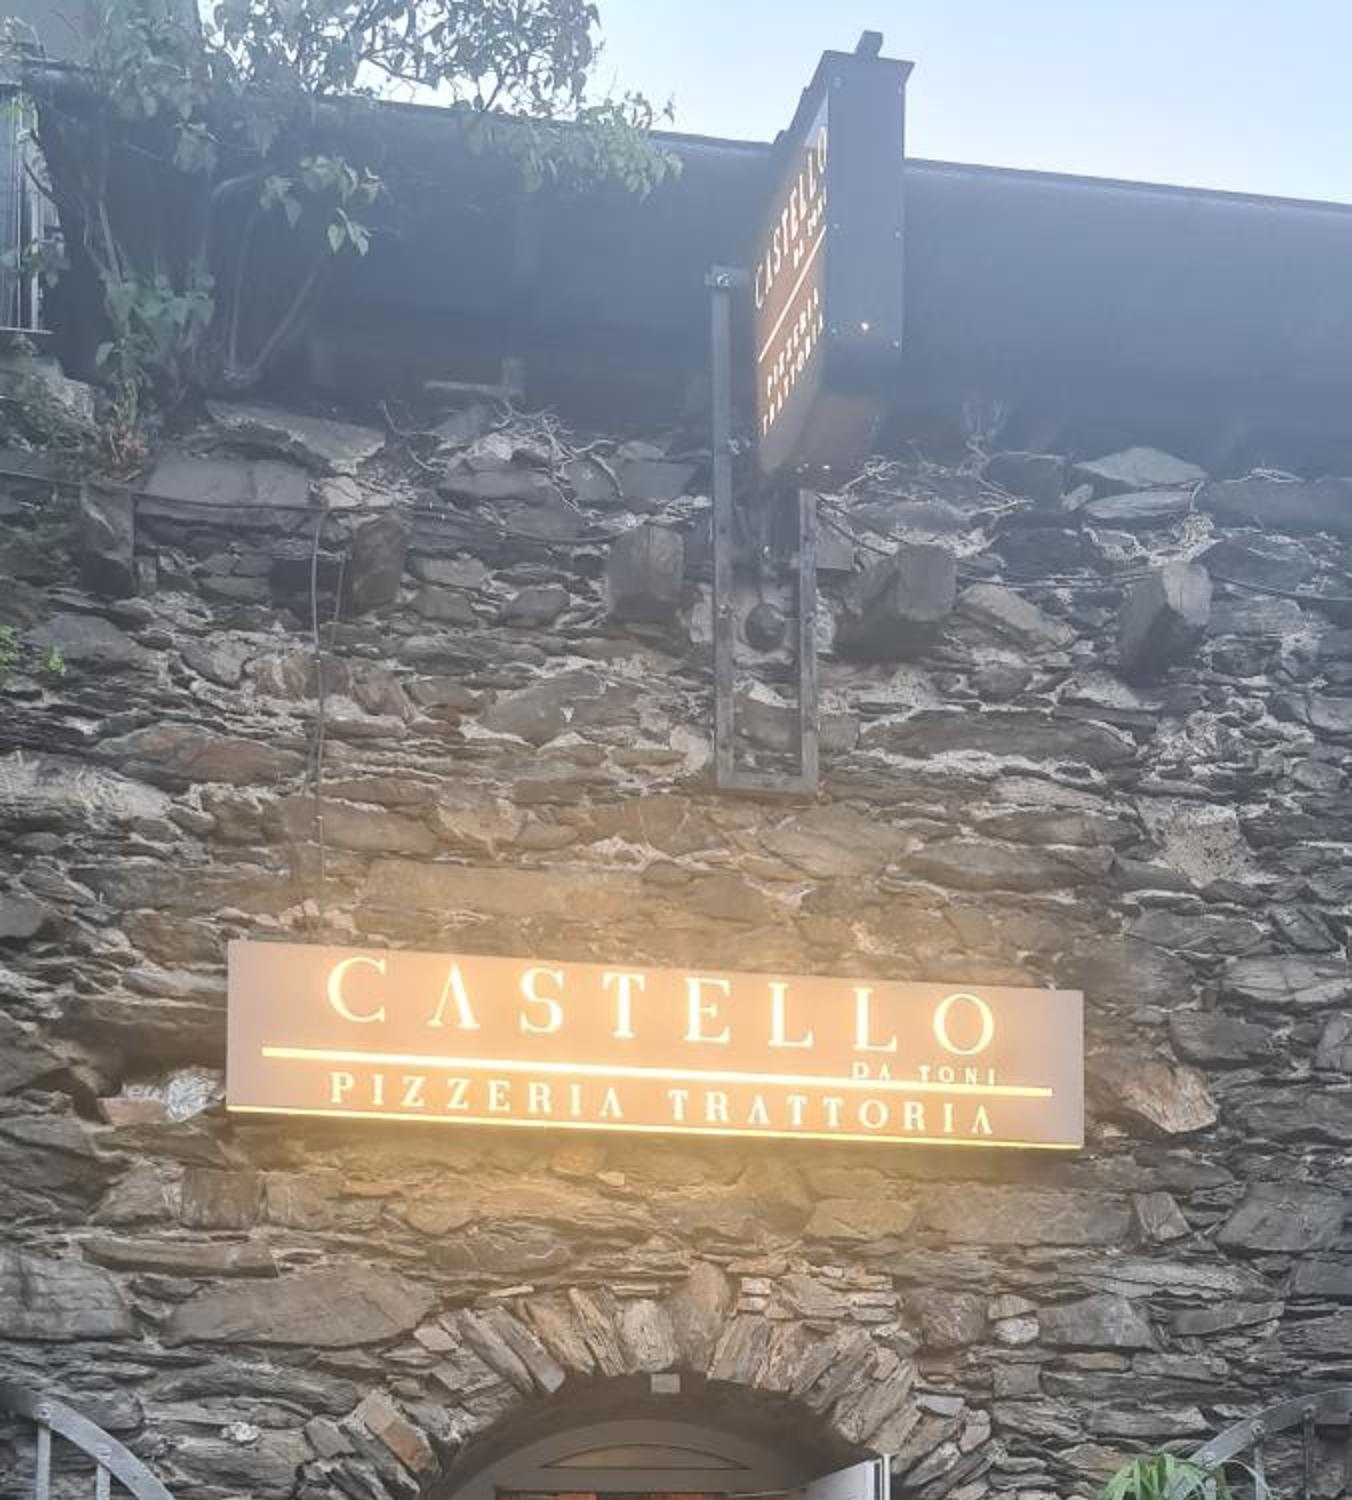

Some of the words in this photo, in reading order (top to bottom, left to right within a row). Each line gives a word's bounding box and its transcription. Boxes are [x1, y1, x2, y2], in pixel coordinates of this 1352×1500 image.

[755, 126, 827, 309] CASTELLO
[763, 313, 823, 435] TRATTORIA
[767, 287, 819, 397] PIZZERIA
[327, 956, 994, 1056] CASTELLO
[330, 1071, 624, 1119] PIZZERIA
[668, 1089, 993, 1136] TRATTORIA
[852, 1061, 891, 1083] DA
[919, 1065, 996, 1087] TONI
